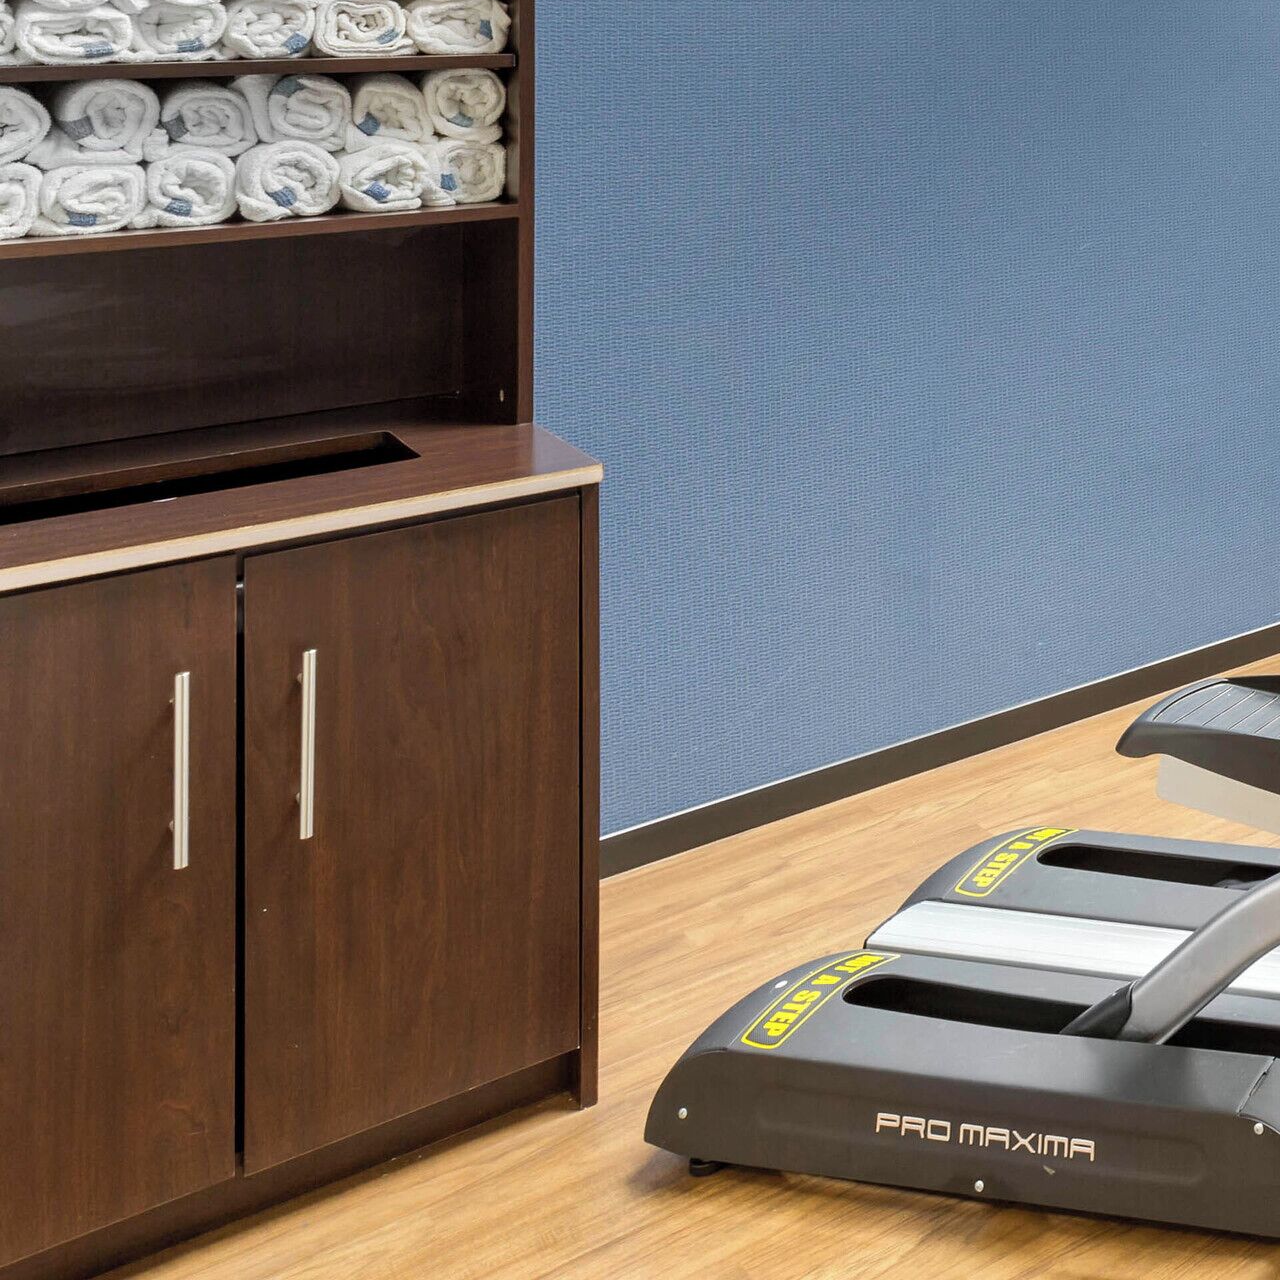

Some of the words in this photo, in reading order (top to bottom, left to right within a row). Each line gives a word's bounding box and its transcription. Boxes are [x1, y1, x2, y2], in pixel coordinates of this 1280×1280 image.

[972, 852, 1020, 888] STEP
[811, 974, 842, 985] A
[834, 954, 885, 974] NOT
[763, 989, 822, 1037] STEP
[875, 1112, 952, 1142] PRO
[958, 1123, 1095, 1162] MAXIMA
